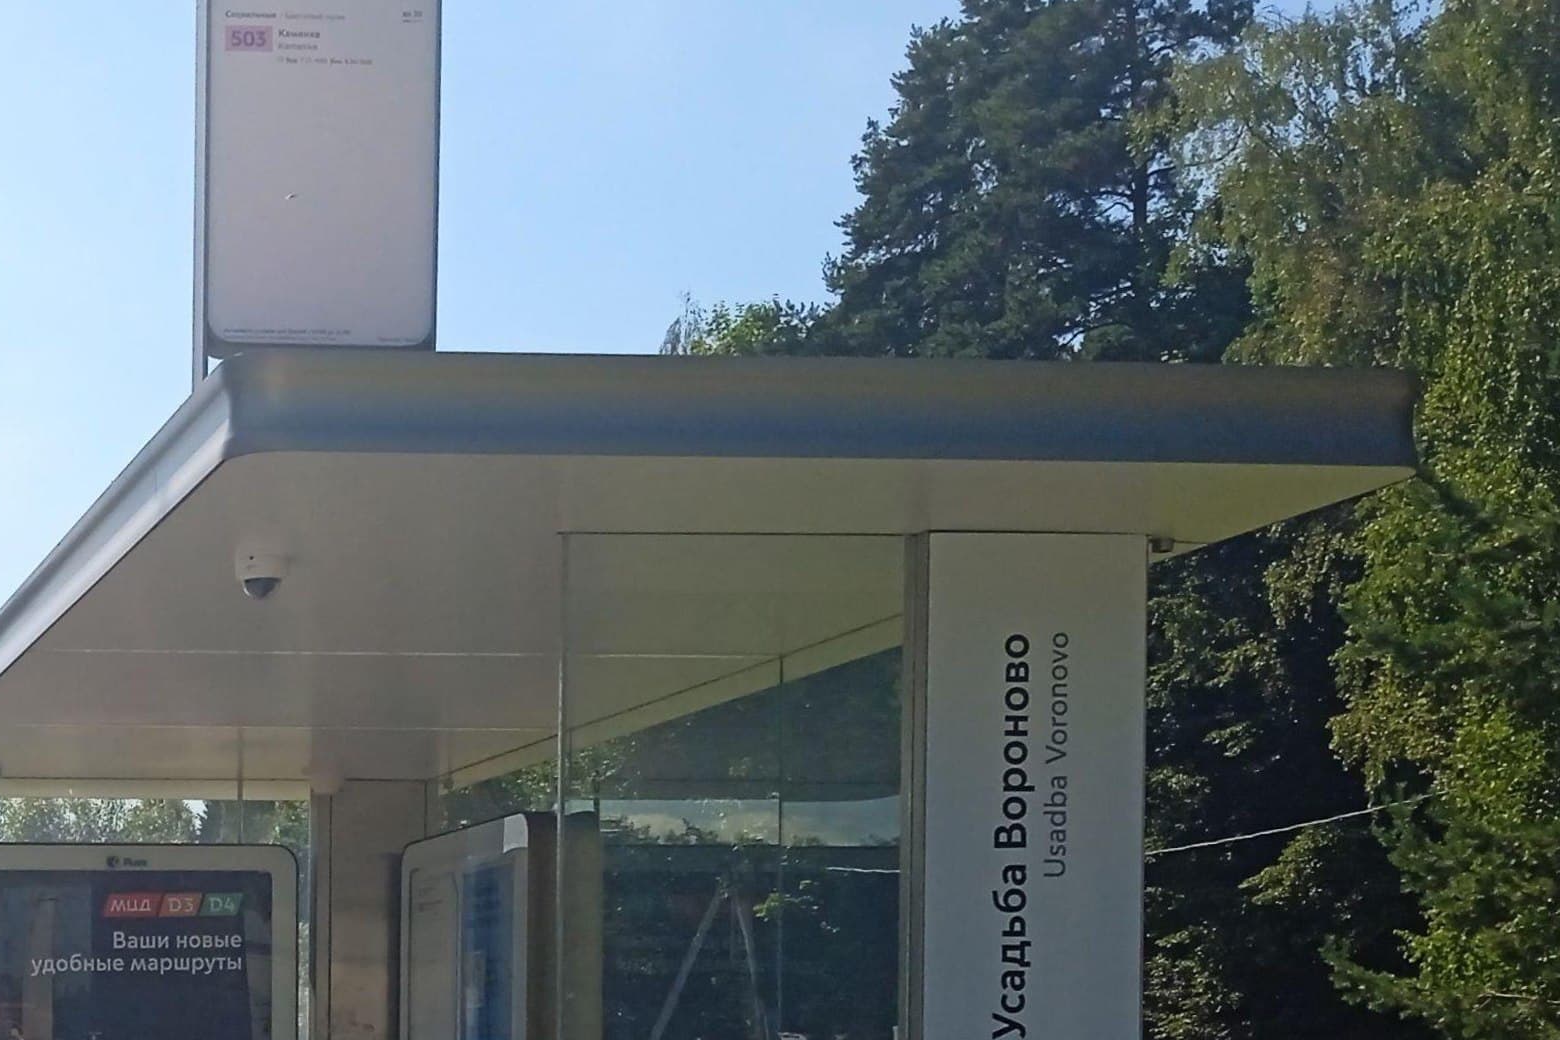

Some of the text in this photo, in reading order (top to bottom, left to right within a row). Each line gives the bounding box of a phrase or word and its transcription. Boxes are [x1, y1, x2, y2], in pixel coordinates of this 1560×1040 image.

[230, 30, 267, 47] 503
[1042, 630, 1070, 879] Usadba Voronovo
[991, 632, 1036, 1040] Усадьба Вороново
[110, 897, 236, 913] МЦД D3 D4
[112, 931, 243, 949] Ваши новые
[31, 953, 243, 977] удобные маршруты
